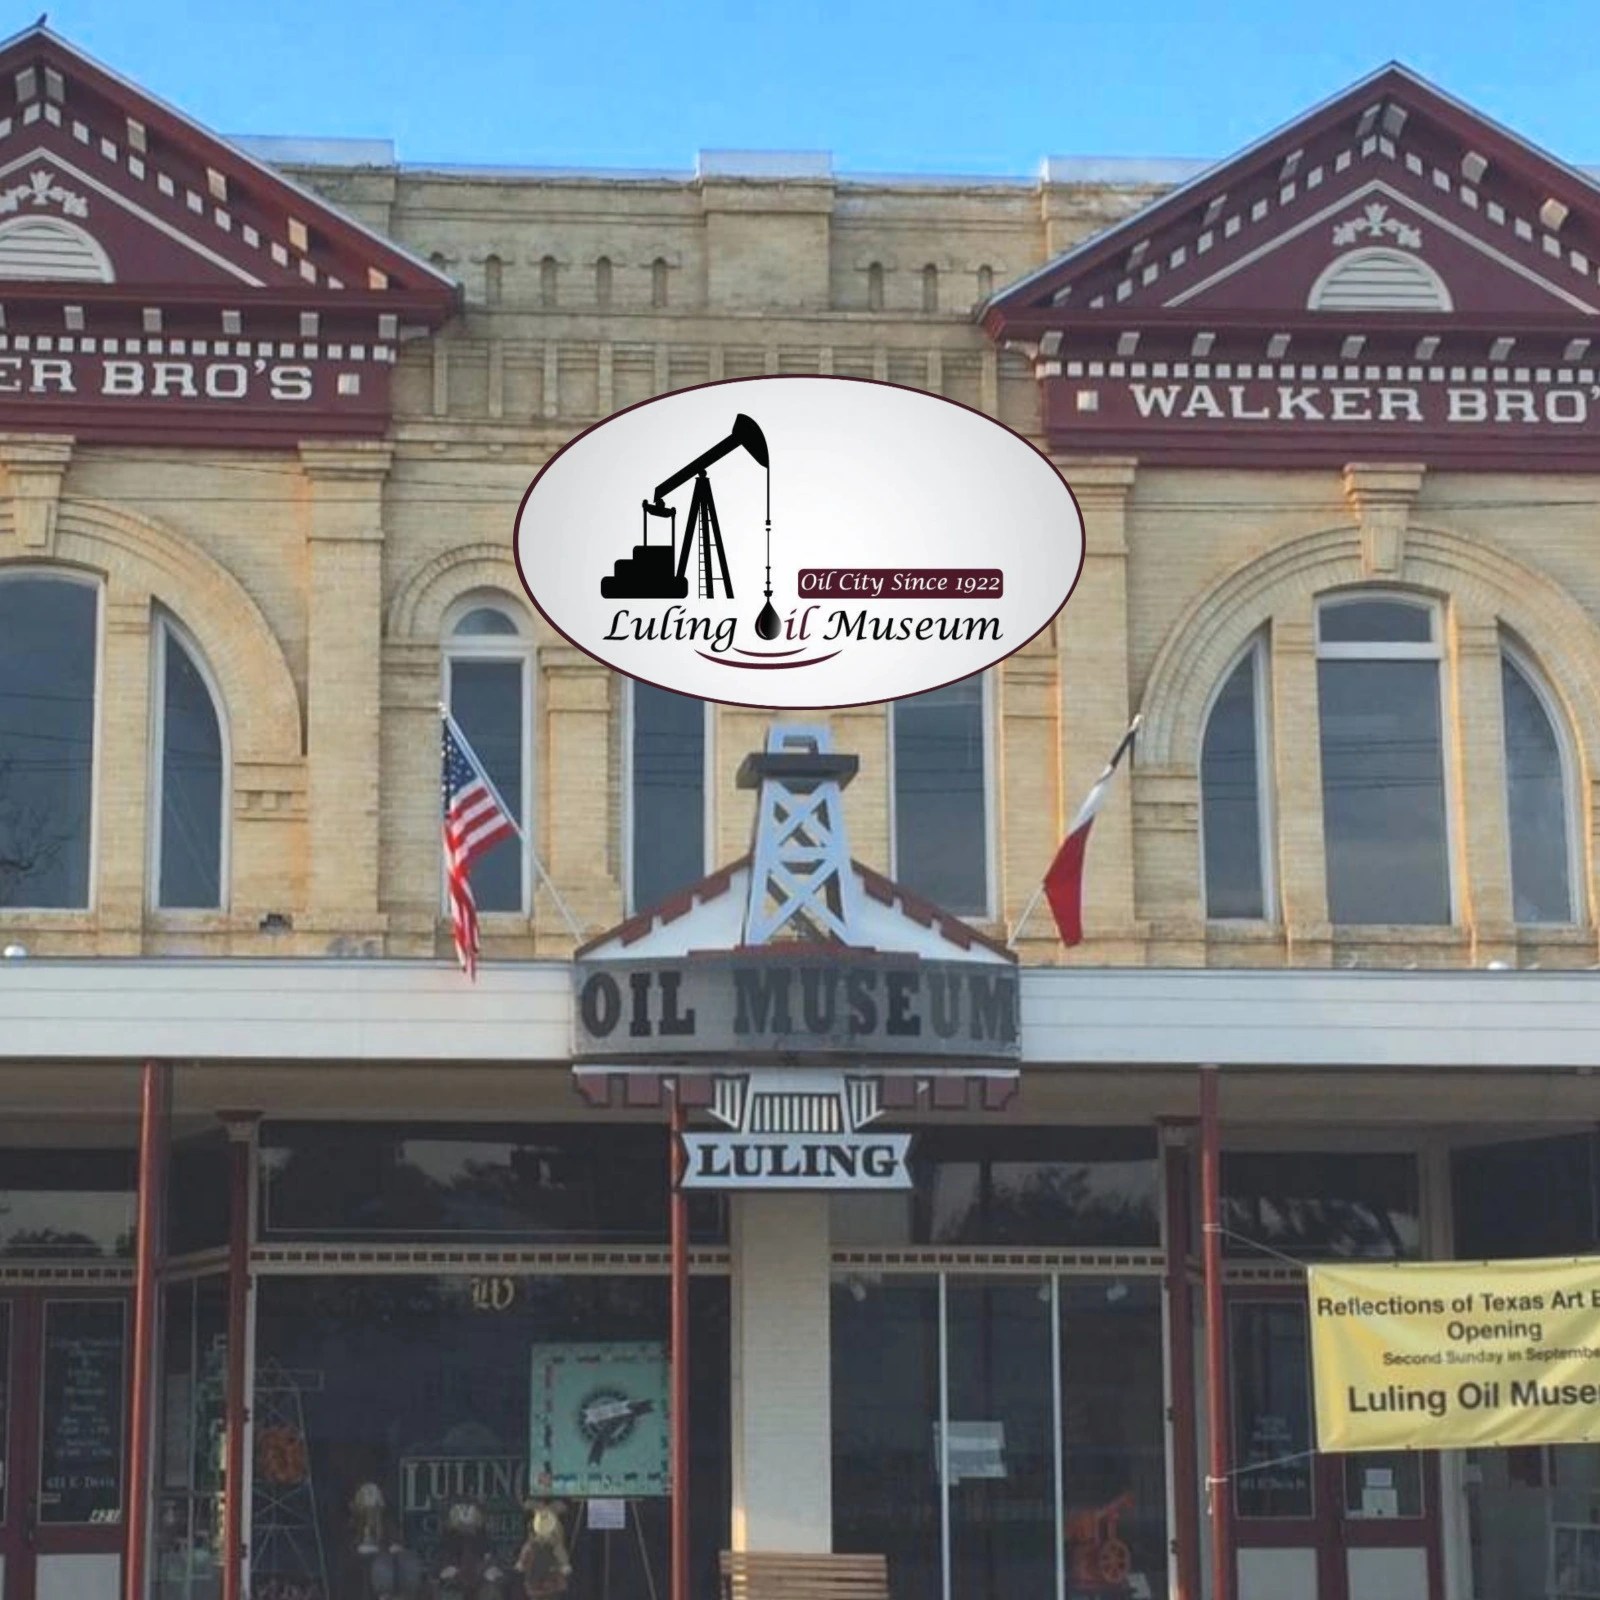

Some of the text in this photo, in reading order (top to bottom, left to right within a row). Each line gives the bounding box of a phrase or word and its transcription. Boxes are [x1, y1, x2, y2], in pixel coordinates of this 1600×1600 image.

[101, 359, 313, 400] BRO'S
[1130, 384, 1424, 422] WALKER
[580, 968, 1020, 1044] OIL MUSEUM
[697, 1144, 898, 1178] LULING
[1317, 1296, 1445, 1316] Reflections
[1452, 1296, 1473, 1313] of
[1480, 1293, 1544, 1312] Texas
[1551, 1290, 1584, 1310] Art
[1447, 1321, 1543, 1343] Opening
[1383, 1352, 1442, 1365] Second
[1446, 1350, 1504, 1365] Sunday
[1508, 1350, 1522, 1361] in
[1349, 1379, 1600, 1417] Luling Oil Muse
